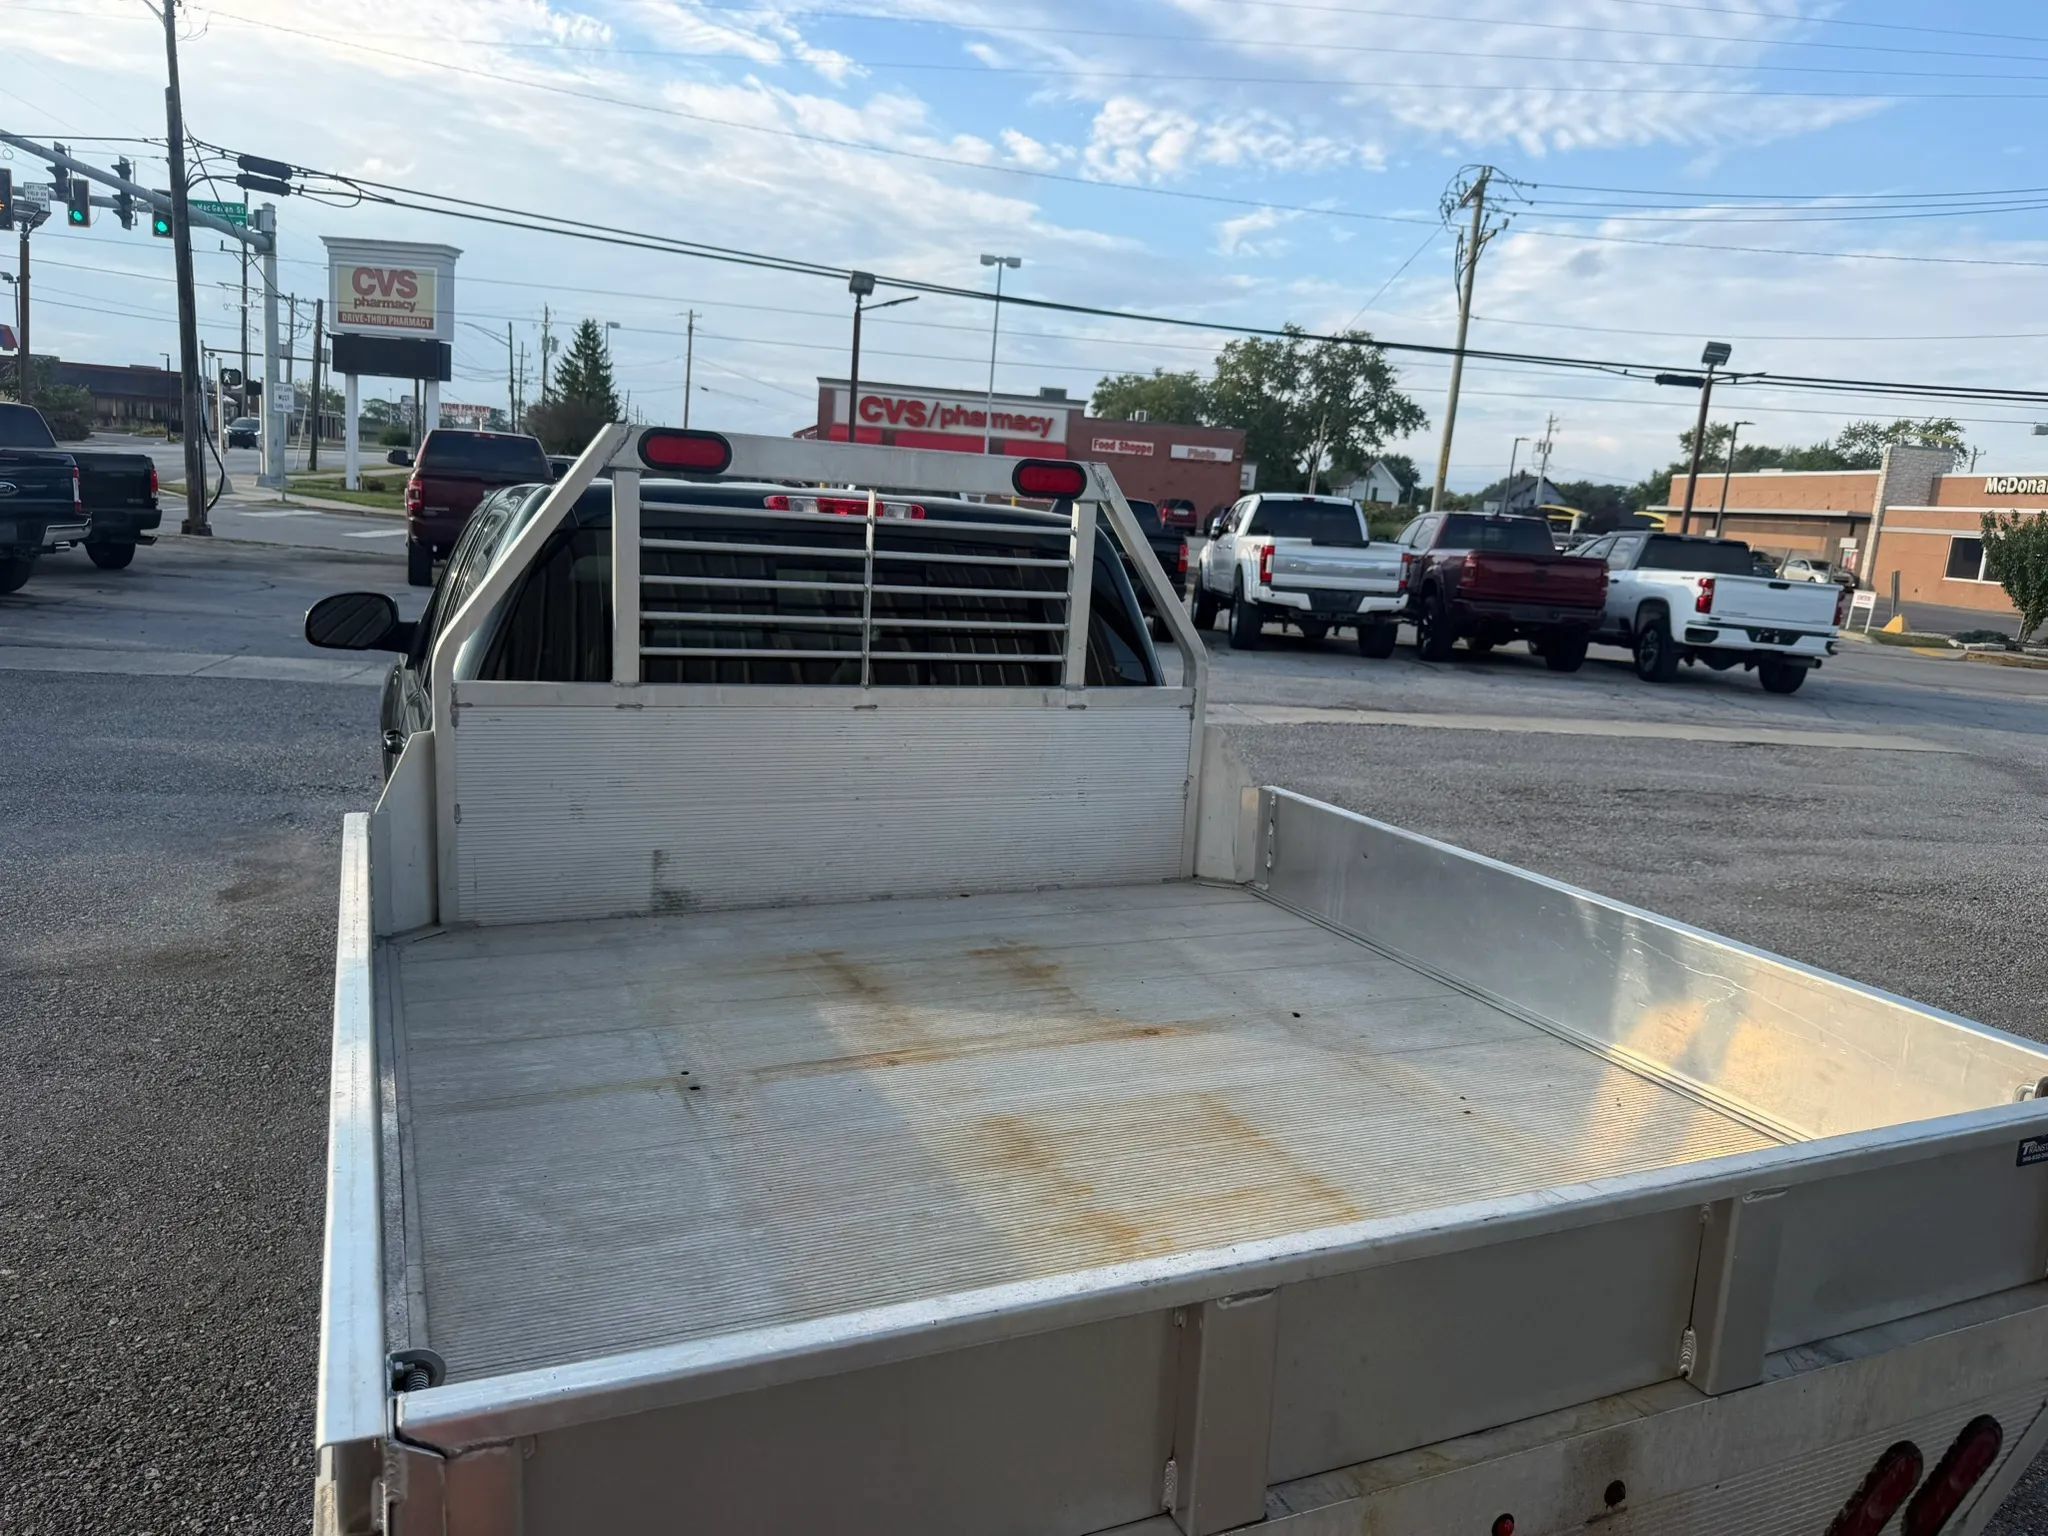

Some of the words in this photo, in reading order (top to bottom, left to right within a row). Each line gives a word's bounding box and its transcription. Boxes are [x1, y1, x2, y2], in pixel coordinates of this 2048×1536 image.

[352, 266, 418, 299] CVS
[353, 296, 416, 312] pharmacy
[341, 312, 387, 325] DRIVE-THRU
[388, 315, 431, 328] PHARMACY
[1094, 439, 1116, 450] Food
[1118, 441, 1153, 456] Shoppe
[1983, 477, 2048, 494] McDona
